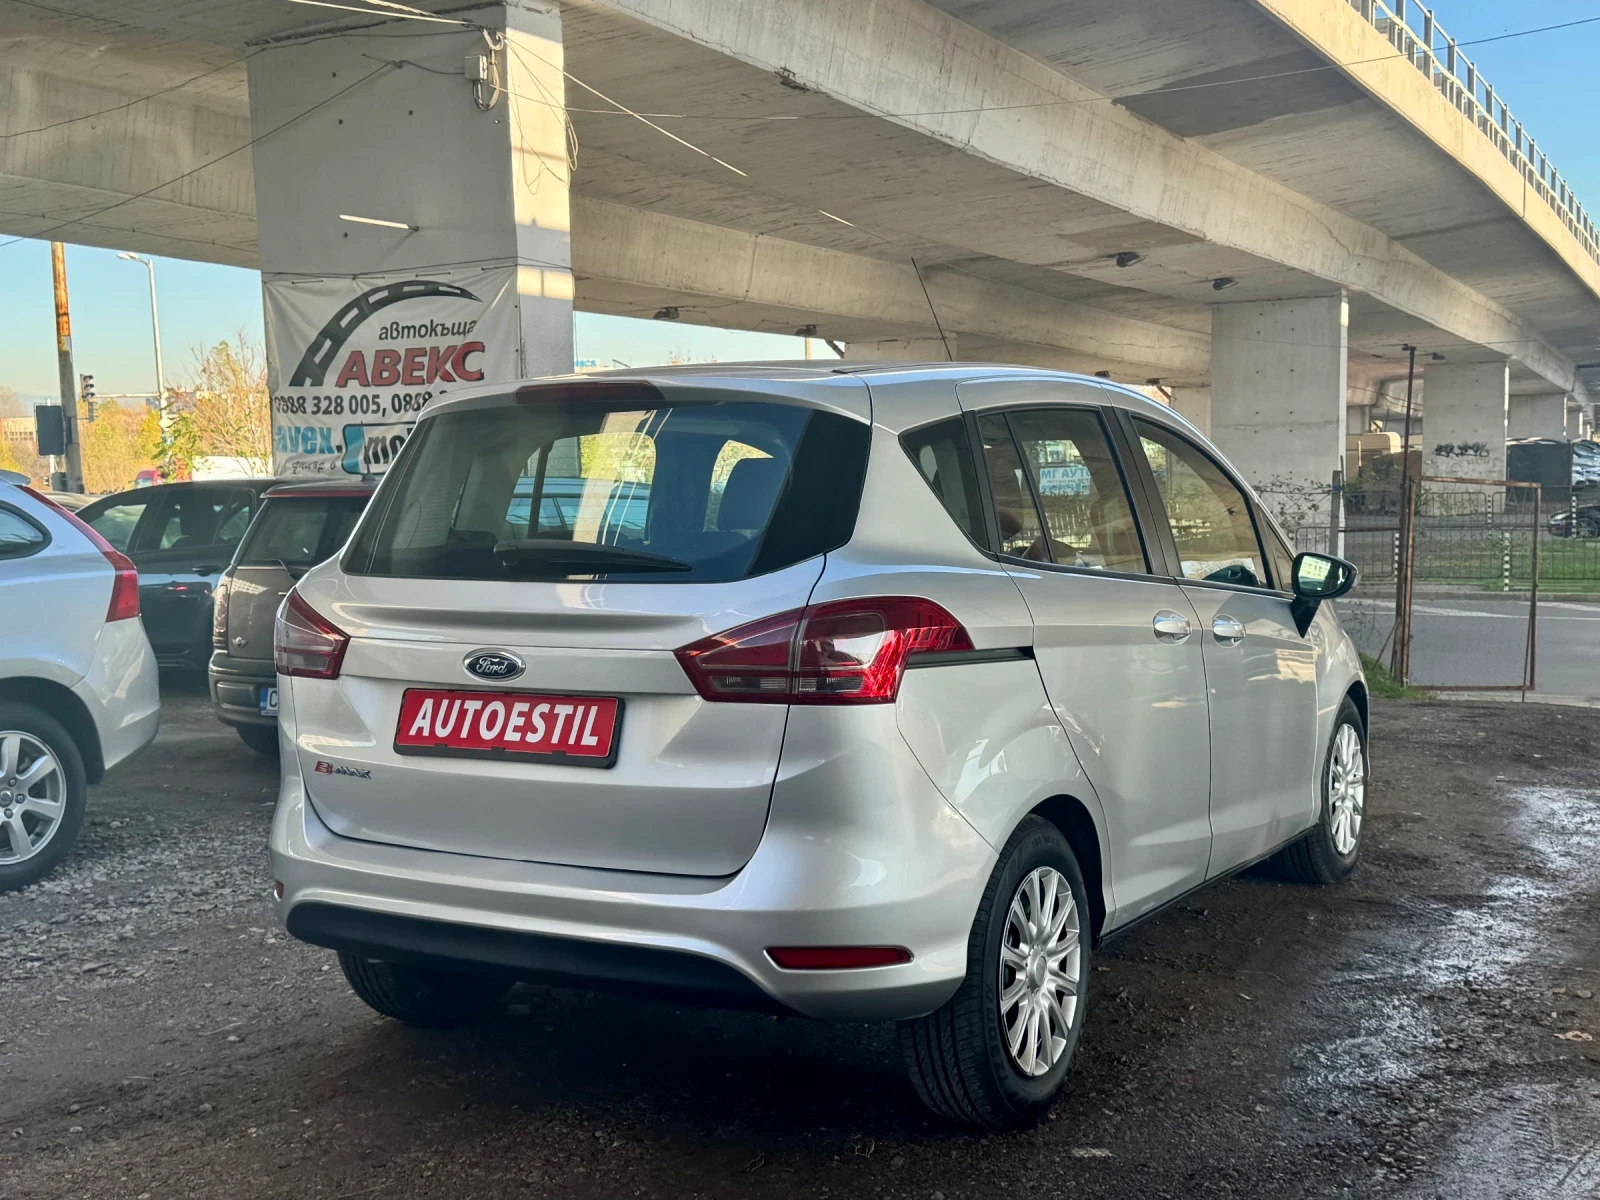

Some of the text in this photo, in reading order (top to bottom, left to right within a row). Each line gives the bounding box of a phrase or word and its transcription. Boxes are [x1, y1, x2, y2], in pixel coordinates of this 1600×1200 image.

[378, 319, 477, 341] автокъща
[335, 341, 485, 388] АВЕКС
[311, 394, 345, 416] 328
[348, 394, 387, 418] 005,
[364, 427, 413, 465] mo
[476, 656, 508, 674] Ford
[408, 697, 600, 746] AUTOESTIL
